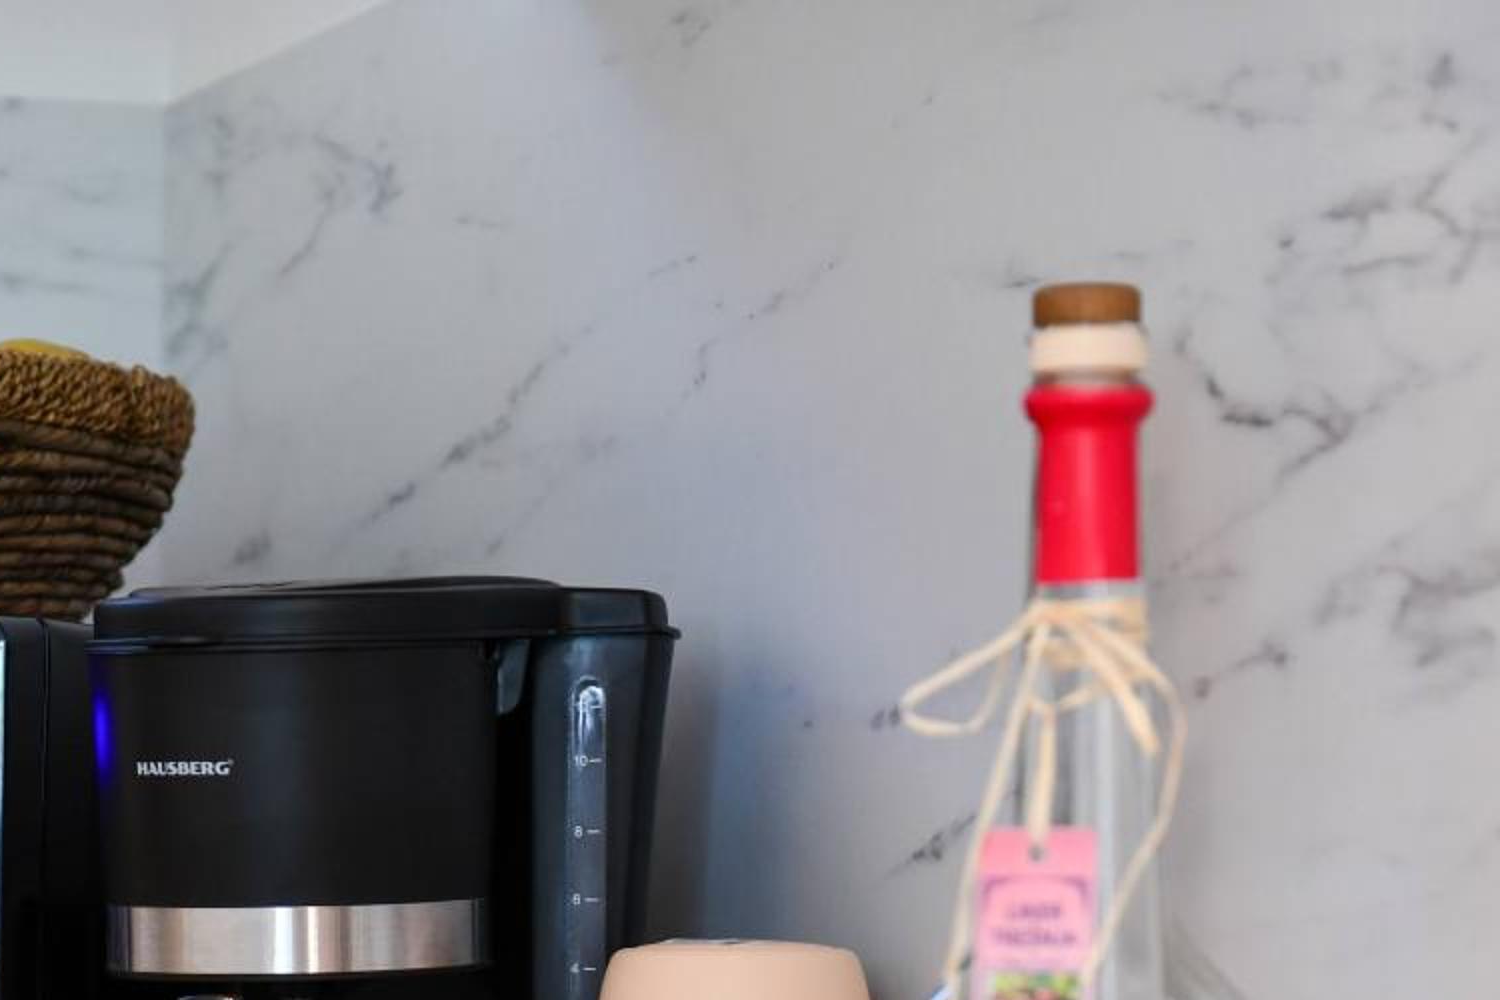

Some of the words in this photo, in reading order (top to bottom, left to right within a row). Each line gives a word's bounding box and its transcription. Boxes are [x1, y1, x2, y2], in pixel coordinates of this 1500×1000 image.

[573, 755, 588, 767] 10
[136, 761, 230, 776] HAUSBERG
[573, 826, 583, 837] 8
